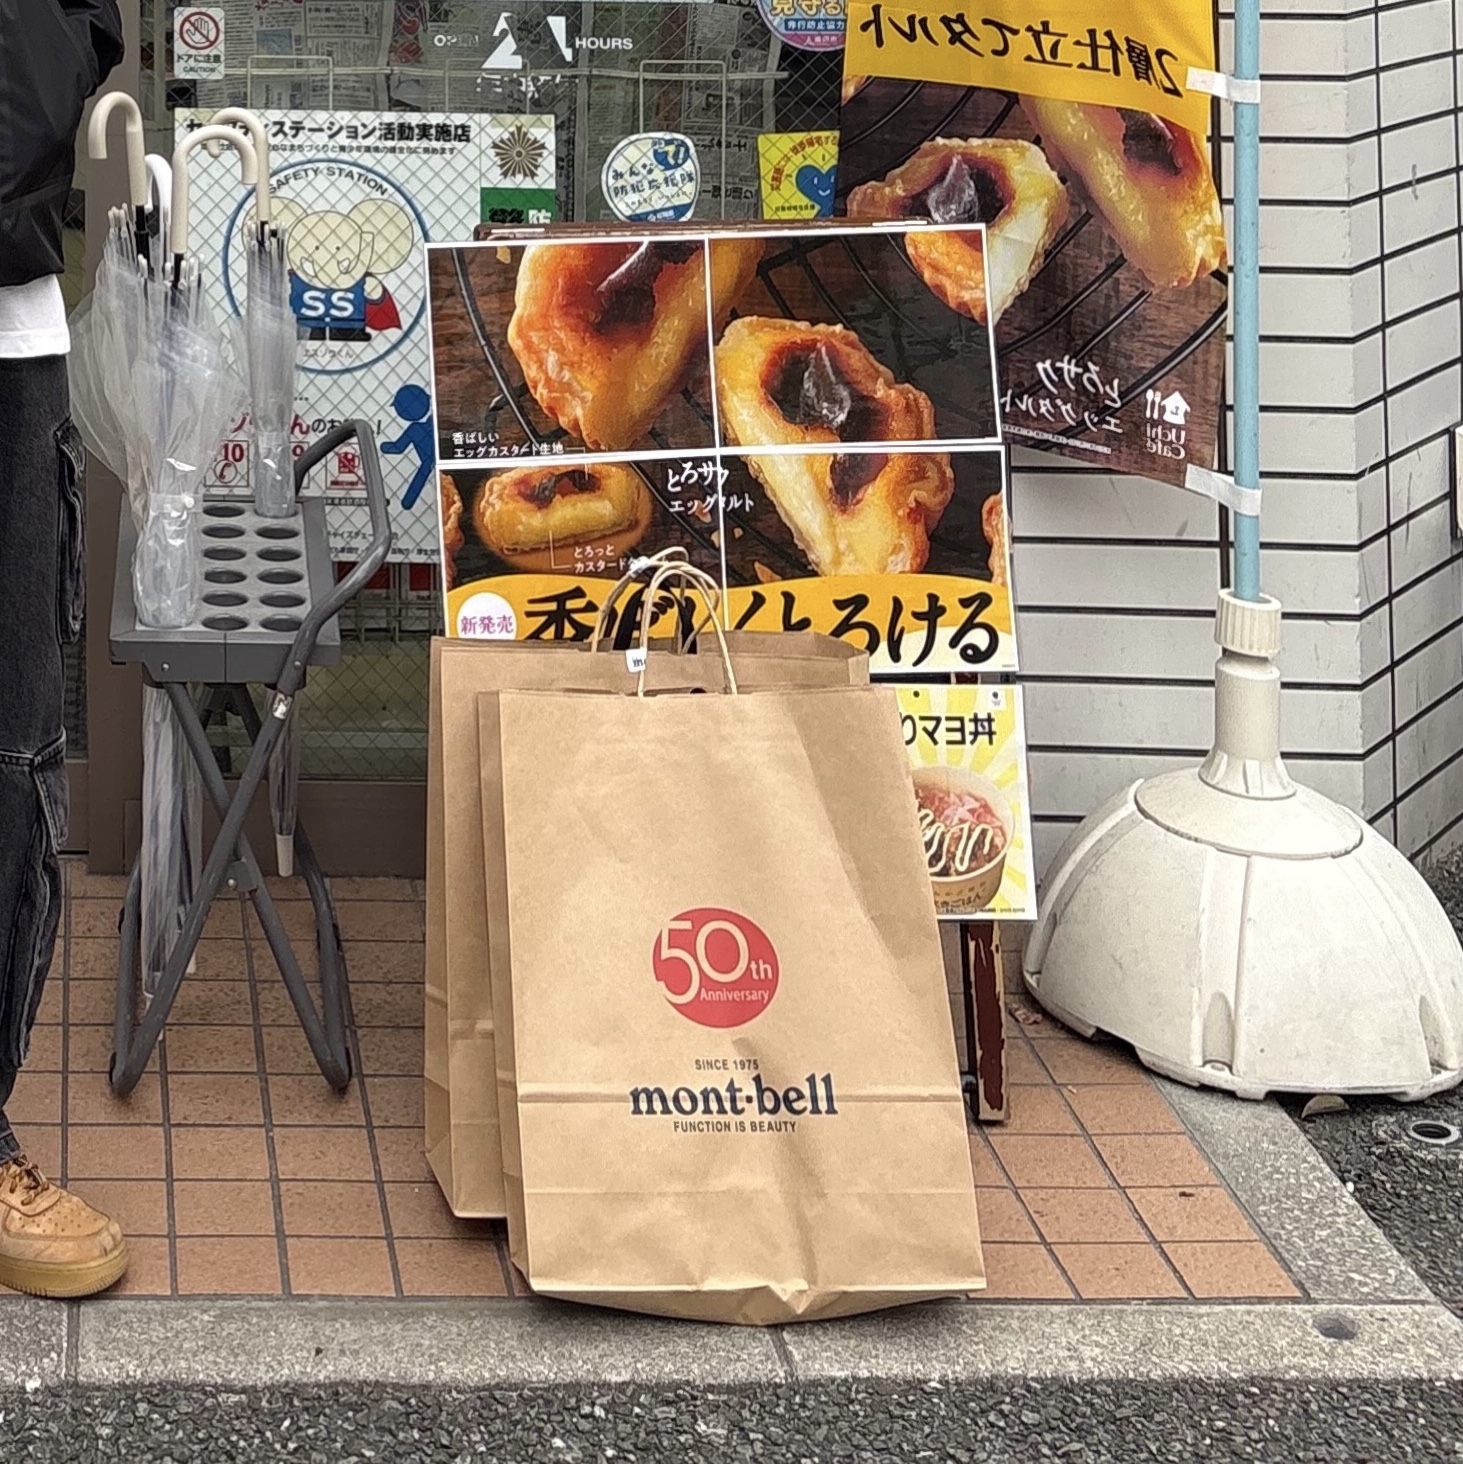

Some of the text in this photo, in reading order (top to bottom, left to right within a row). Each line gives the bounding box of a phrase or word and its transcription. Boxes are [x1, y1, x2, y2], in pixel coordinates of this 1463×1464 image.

[575, 37, 634, 50] HOURS
[177, 54, 222, 64] ドアに注意
[268, 164, 389, 197] SAFETY STATION
[301, 289, 355, 318] SS
[452, 432, 500, 445] 香ばしい
[453, 444, 565, 458] エッグカスタード生地
[667, 462, 730, 493] とろサク
[573, 545, 615, 558] とろっと
[460, 617, 515, 636] 新発売
[655, 919, 774, 1005] 50th
[699, 987, 770, 1004] Anniversary
[694, 1058, 759, 1071] SINCE 1975
[673, 1120, 797, 1133] FUNCTION IS BEAUTY
